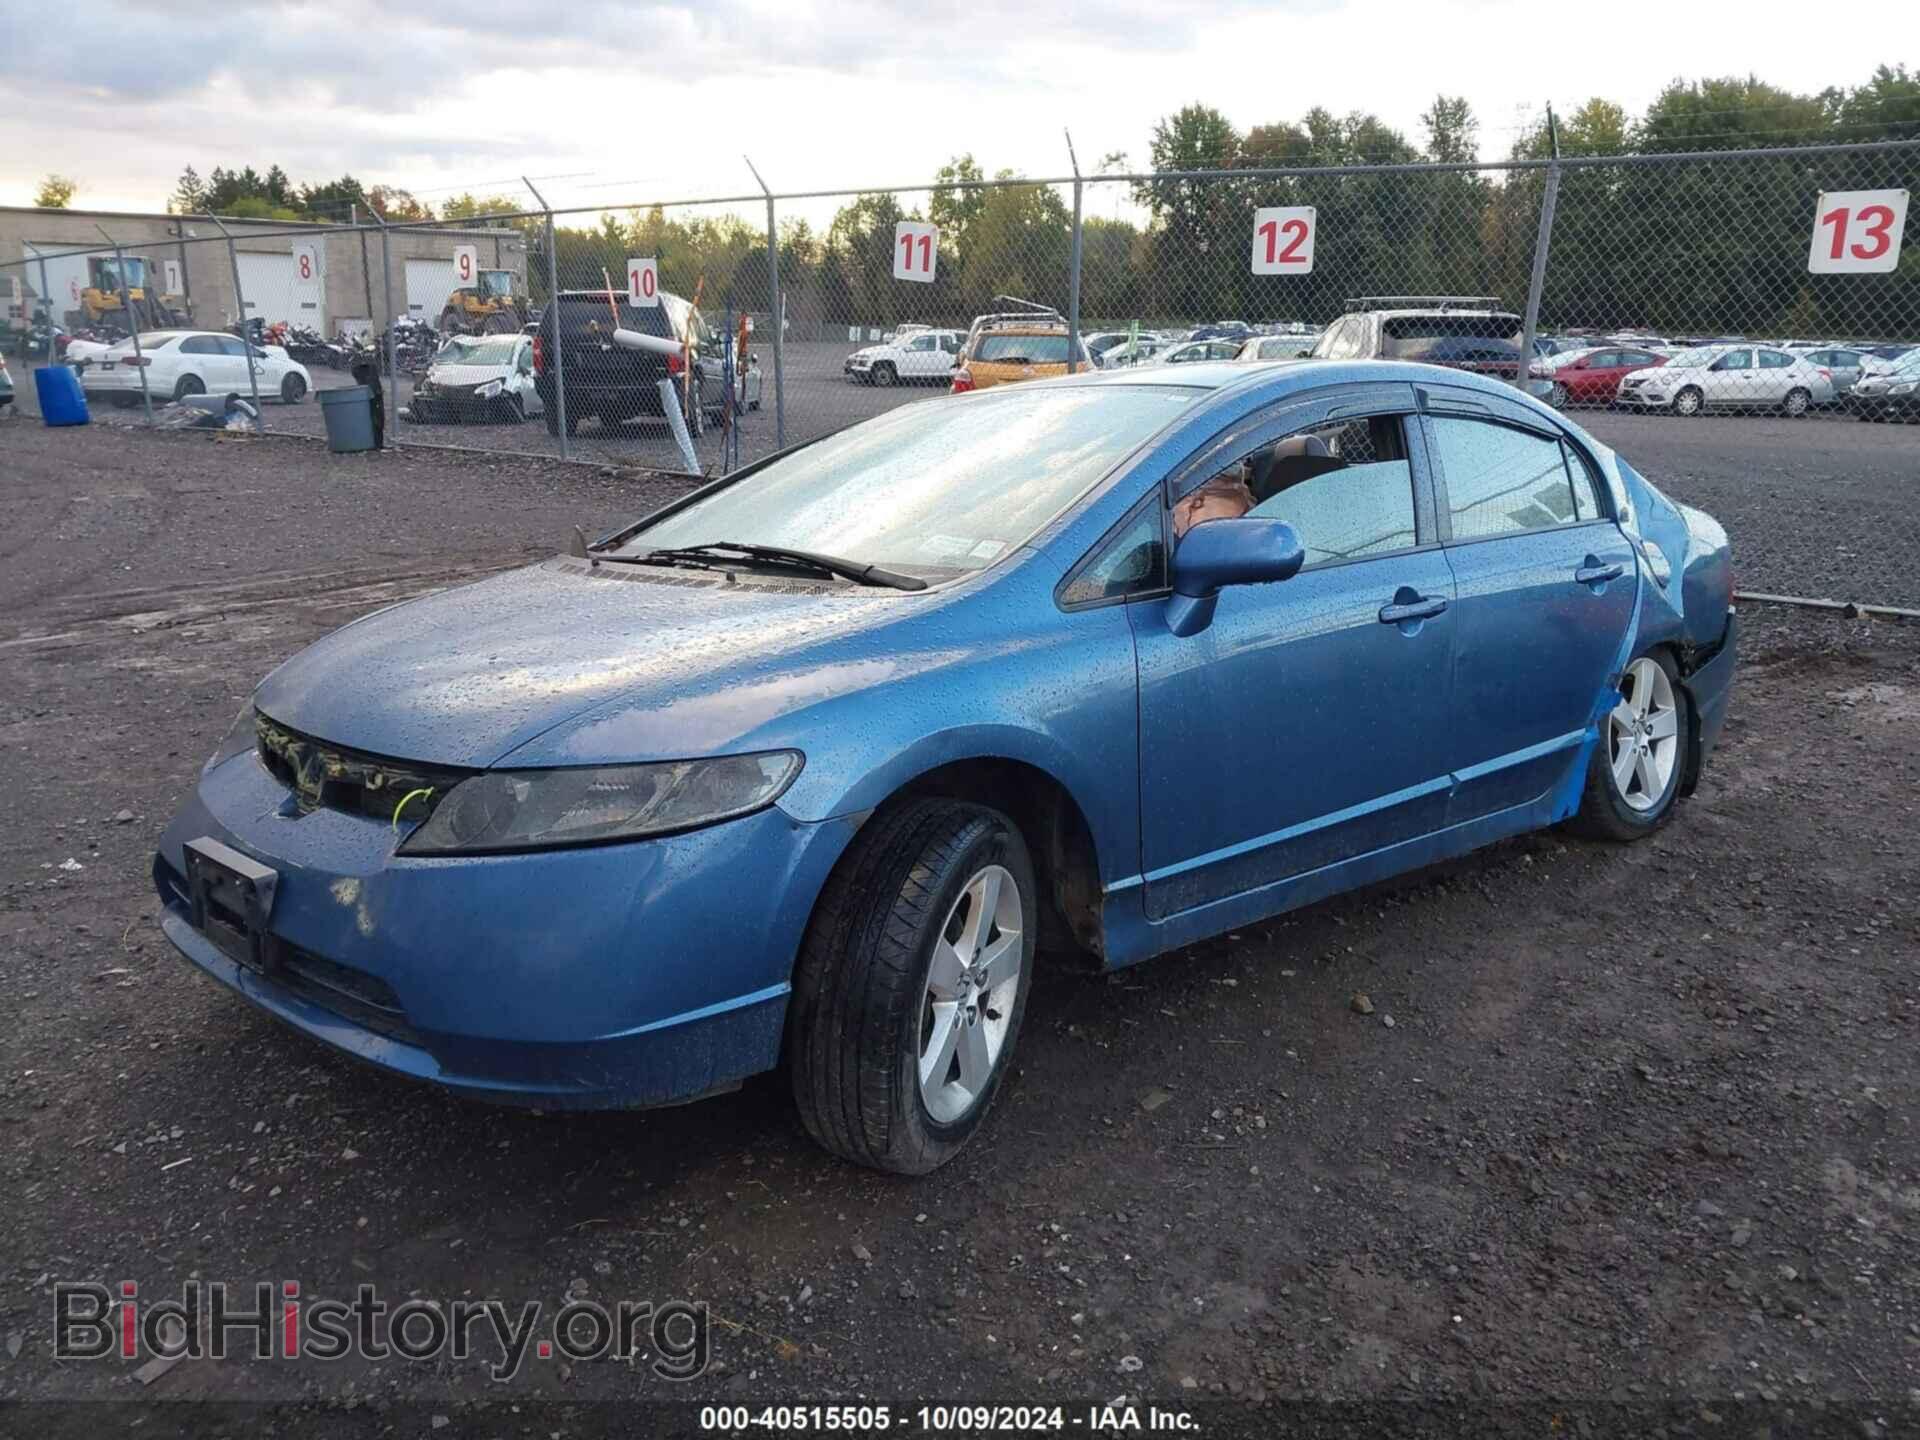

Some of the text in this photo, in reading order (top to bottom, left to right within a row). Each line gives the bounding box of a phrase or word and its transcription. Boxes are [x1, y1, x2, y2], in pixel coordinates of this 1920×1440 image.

[1258, 219, 1308, 264] 12
[1822, 205, 1895, 259] 13
[300, 254, 310, 279] 8
[900, 233, 931, 272] 11
[168, 267, 176, 289] 7
[459, 254, 471, 281] 9
[630, 269, 656, 298] 10
